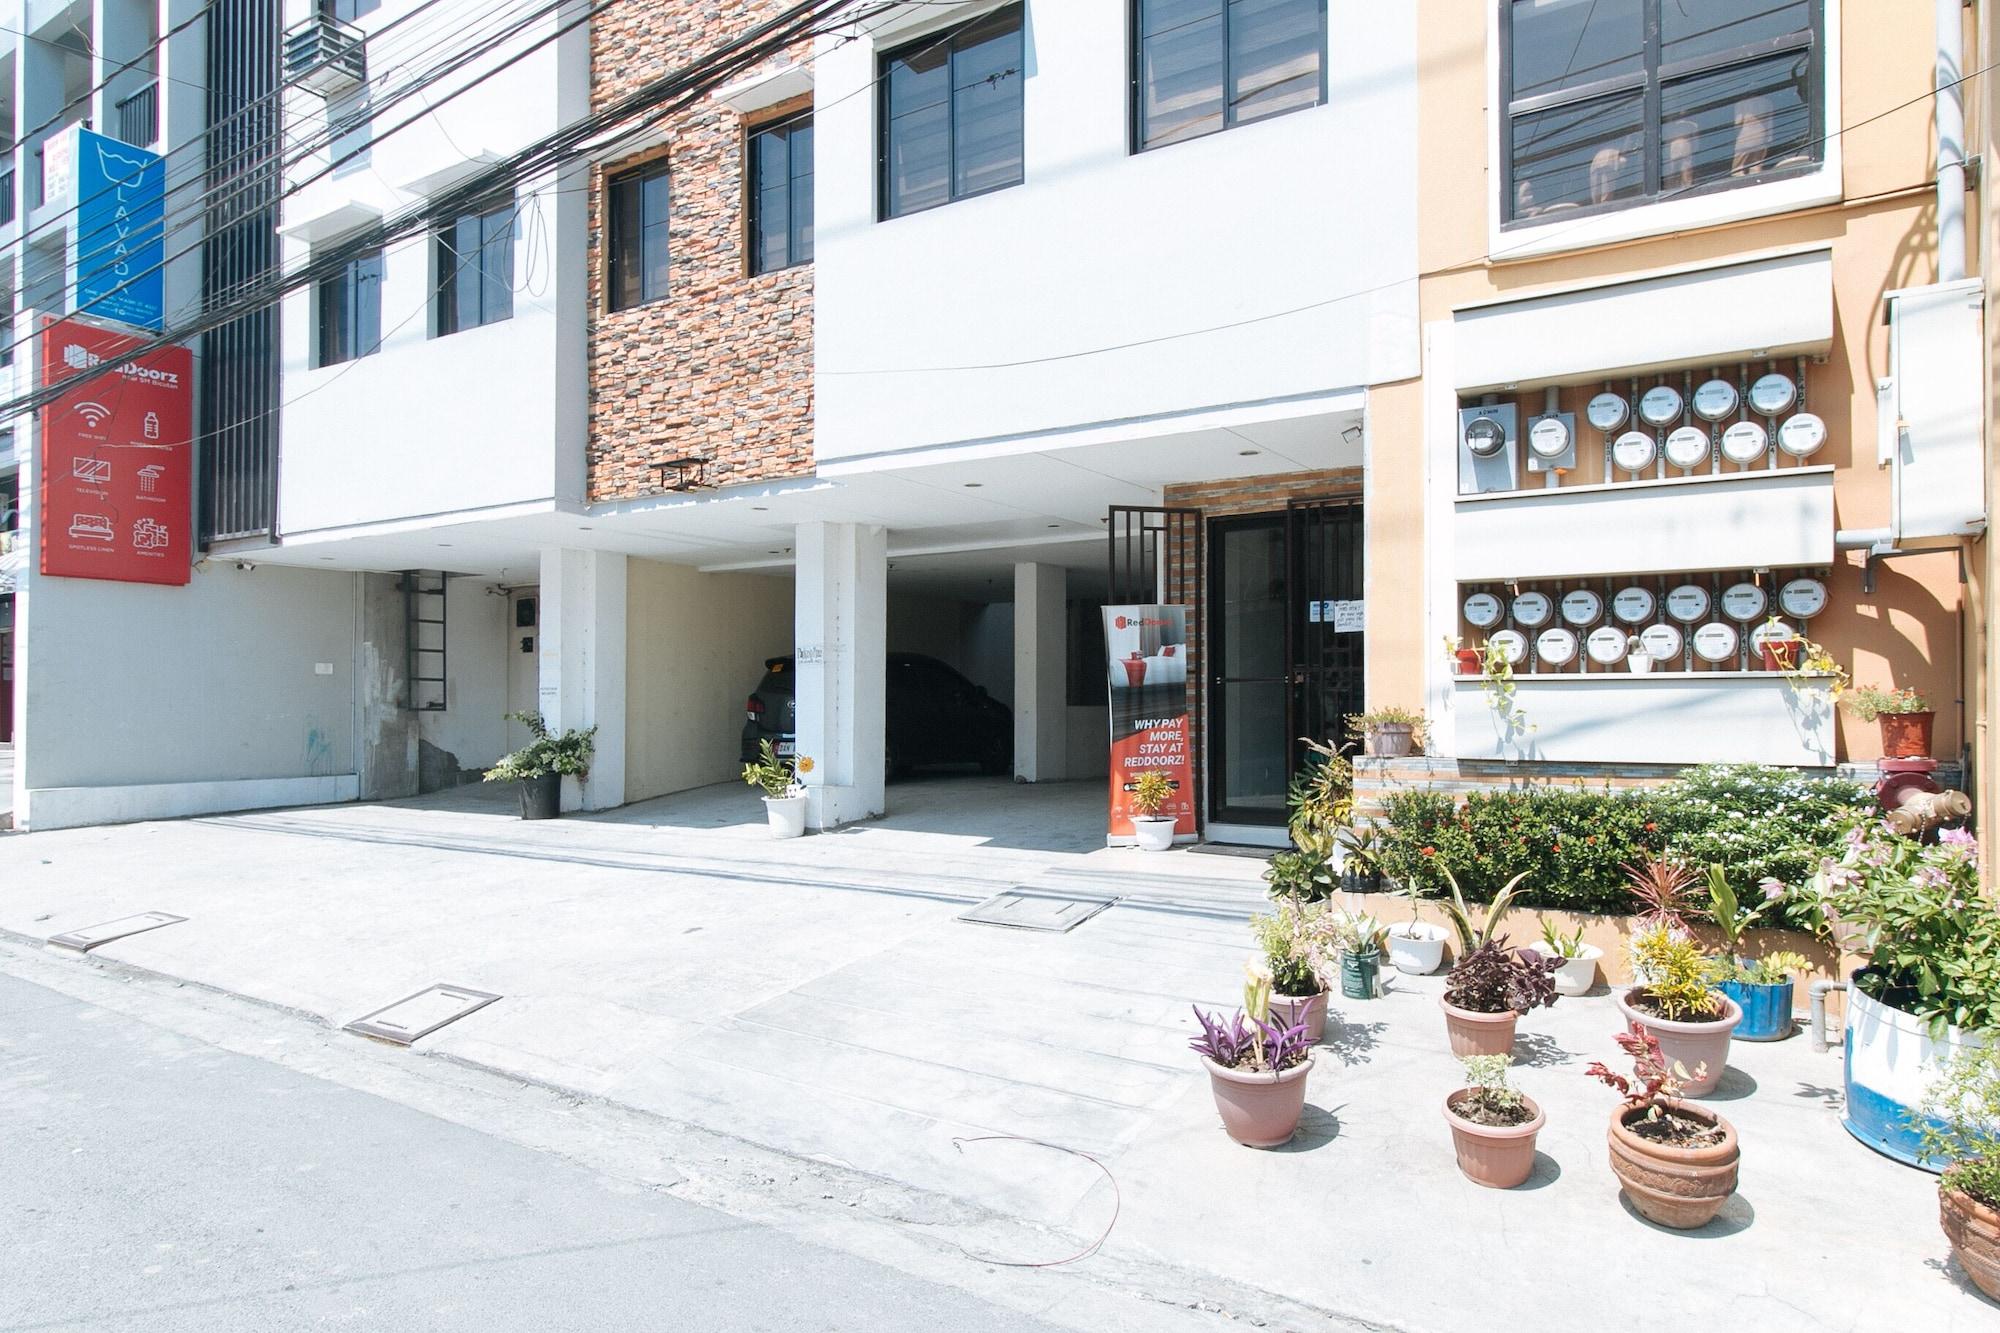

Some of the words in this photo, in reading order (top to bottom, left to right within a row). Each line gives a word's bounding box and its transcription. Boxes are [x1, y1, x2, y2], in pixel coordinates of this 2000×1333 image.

[1134, 719, 1161, 730] WHY
[1161, 718, 1183, 729] PAY
[1150, 731, 1183, 742] MORE,
[1139, 743, 1167, 754] STAY
[1168, 742, 1183, 753] AT
[1124, 755, 1185, 767] REDDOORZ!
